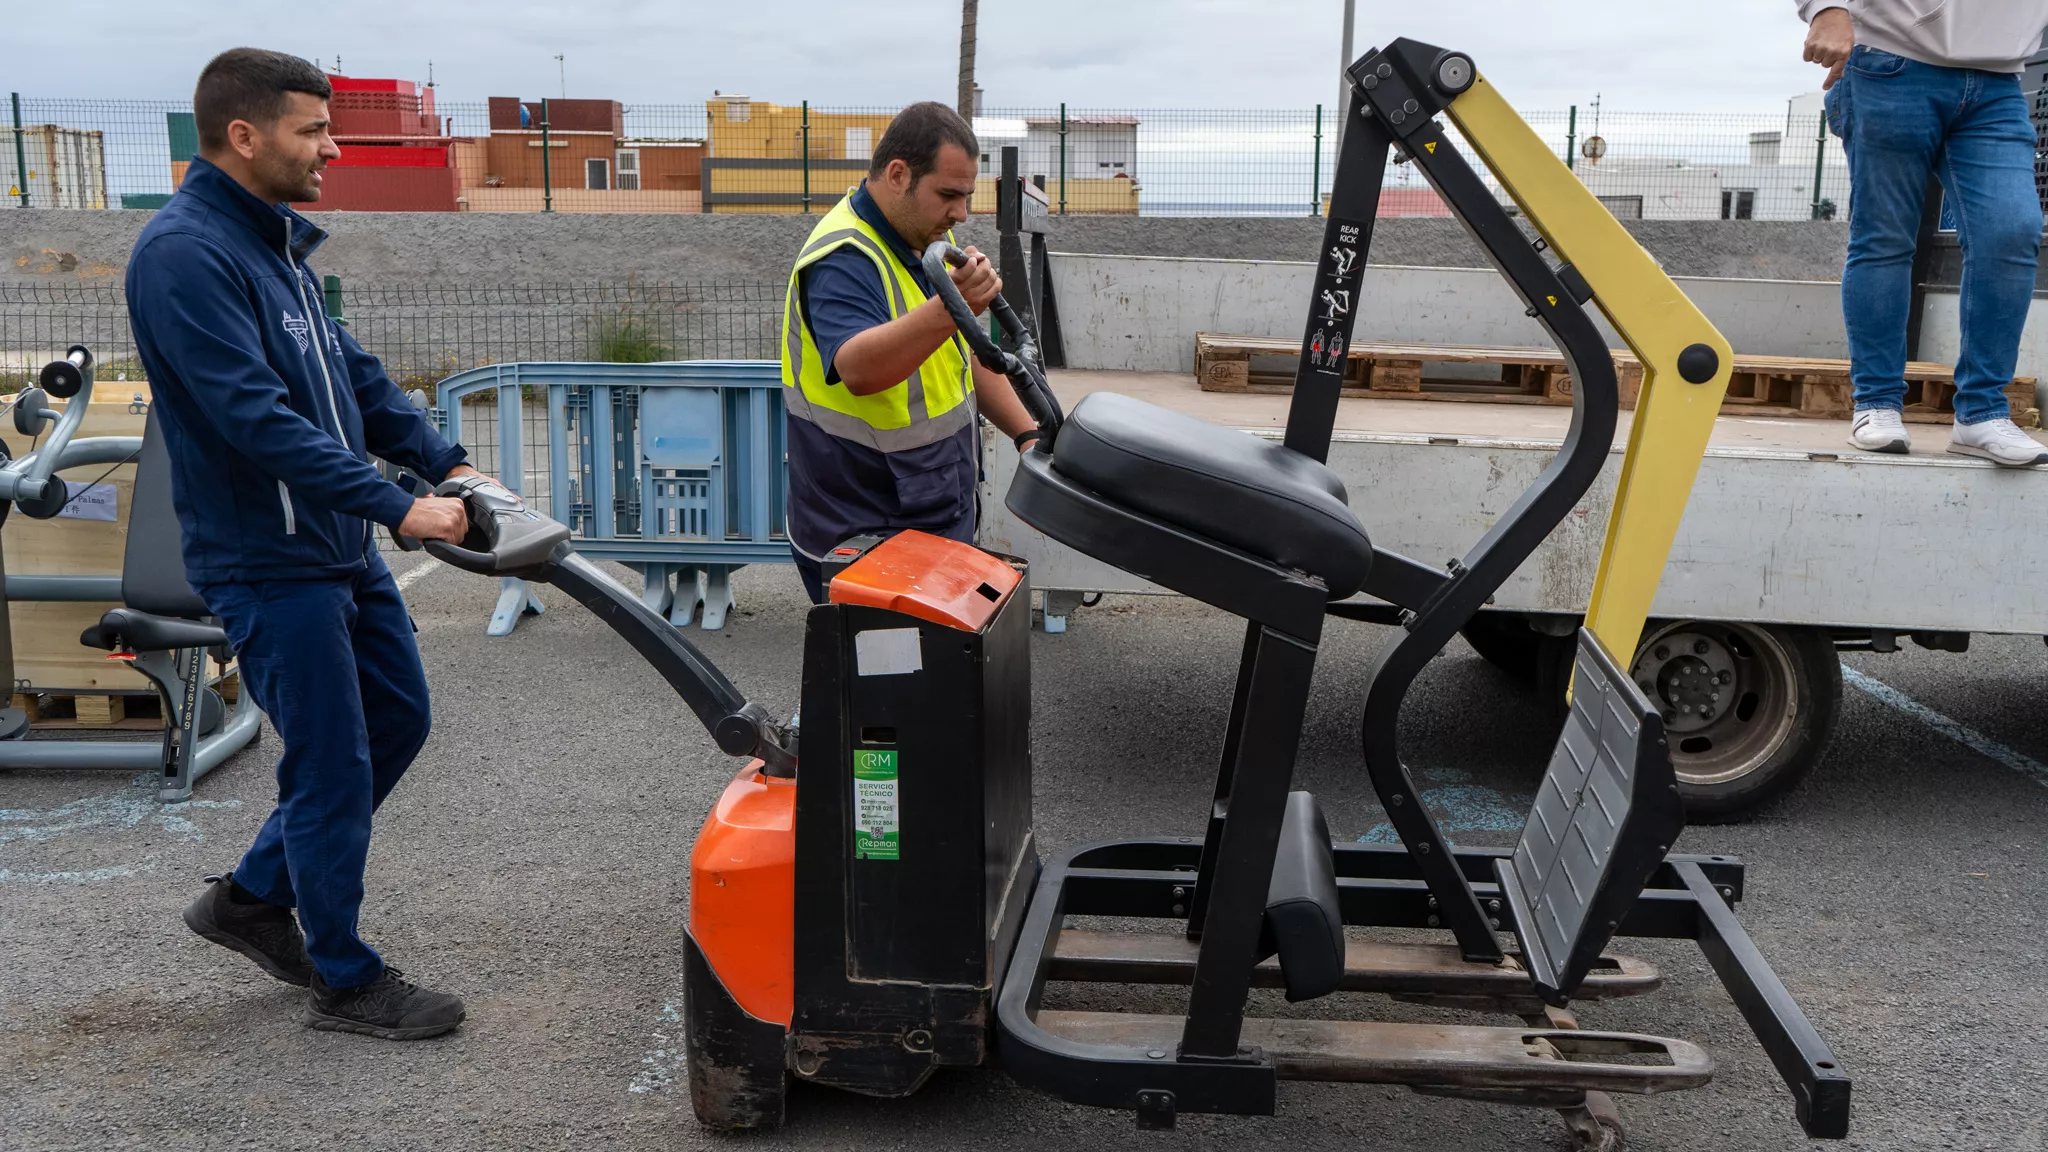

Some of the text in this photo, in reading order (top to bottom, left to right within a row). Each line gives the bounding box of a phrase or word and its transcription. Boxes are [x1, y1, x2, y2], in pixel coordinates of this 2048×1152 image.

[1340, 225, 1359, 235] REAR
[1340, 234, 1357, 244] KICK
[78, 496, 104, 504] Palmas
[193, 656, 198, 664] 2
[189, 684, 194, 692] 5
[188, 703, 193, 711] 7
[186, 712, 191, 720] 8
[184, 722, 190, 730] 9
